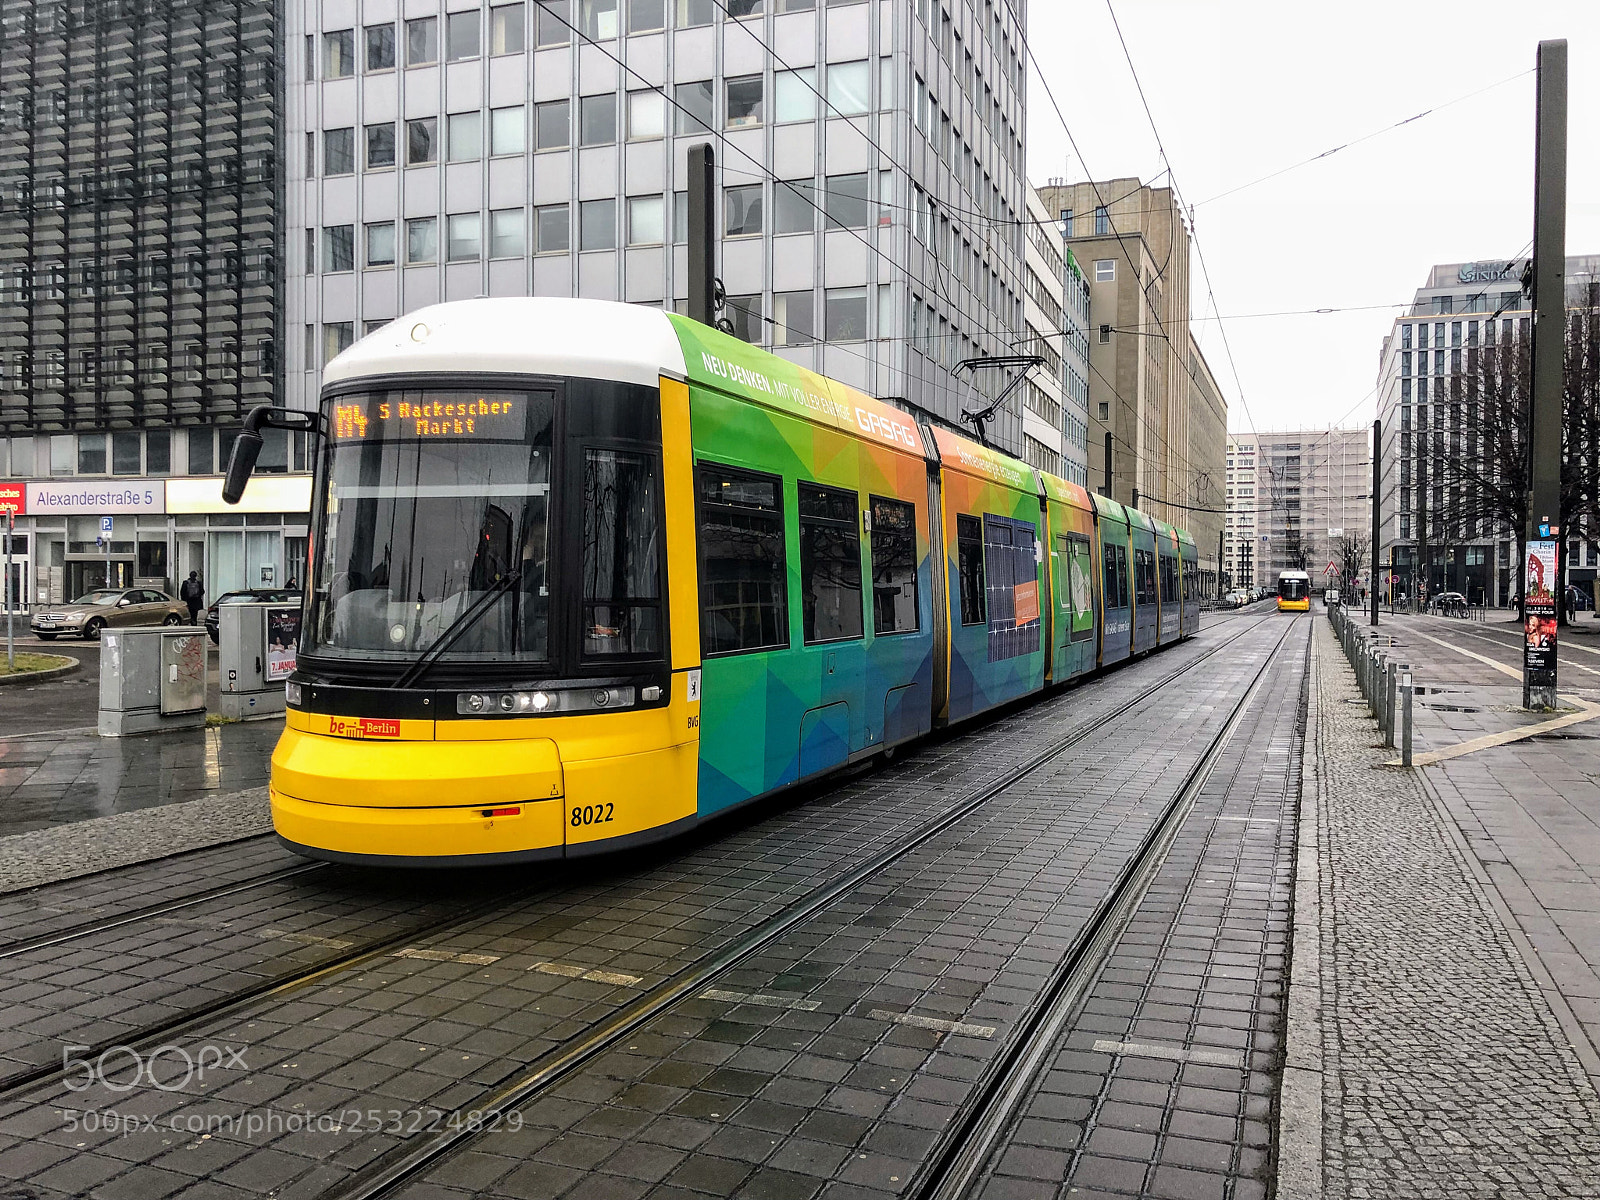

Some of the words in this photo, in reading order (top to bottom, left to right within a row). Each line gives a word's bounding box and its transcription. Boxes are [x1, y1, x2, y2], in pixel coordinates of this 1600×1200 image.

[701, 351, 727, 378] NEU
[727, 361, 774, 395] DENKEN.
[773, 378, 790, 400] MIT
[790, 386, 821, 412] VOLLER
[854, 407, 916, 447] GASAG
[416, 418, 475, 435] Markt
[37, 490, 140, 506] Alexanderstraße
[144, 490, 153, 505] 5
[103, 518, 110, 530] P
[329, 716, 346, 734] be
[366, 722, 397, 734] Berlin
[687, 715, 699, 729] BVG
[571, 802, 614, 827] 8022
